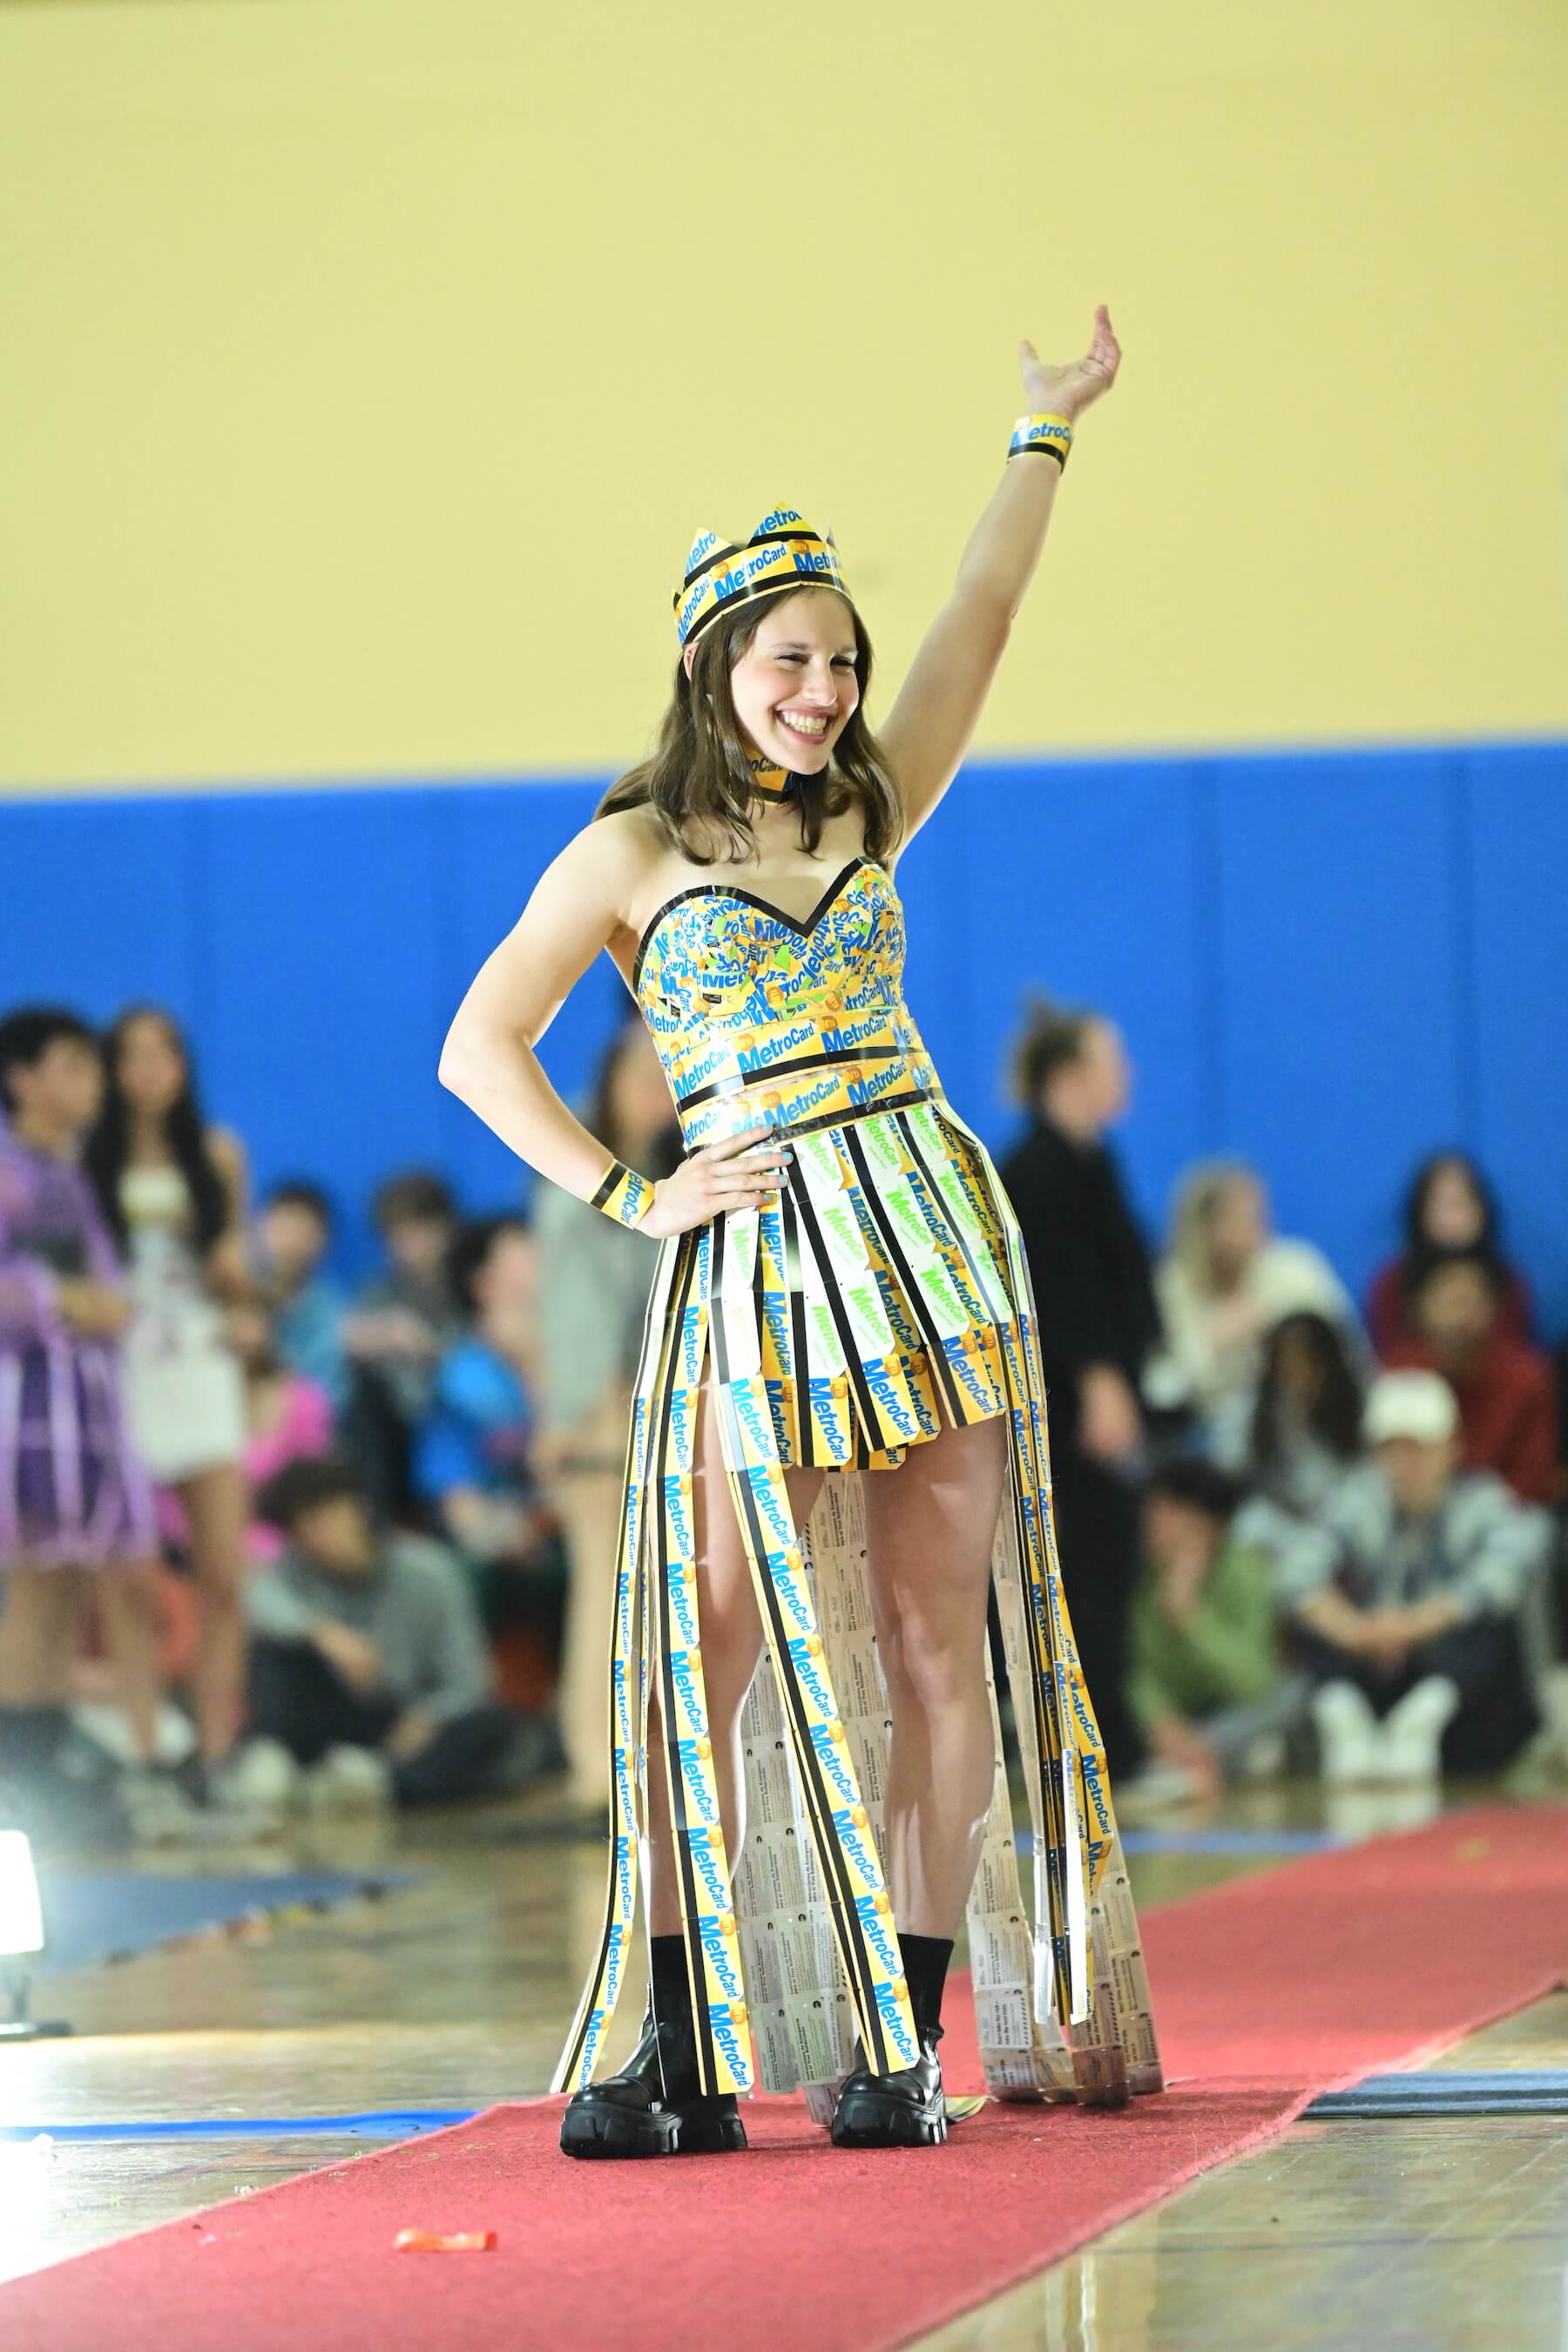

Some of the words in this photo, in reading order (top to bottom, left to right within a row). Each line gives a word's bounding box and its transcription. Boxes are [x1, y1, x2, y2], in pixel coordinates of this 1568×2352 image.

[737, 1022, 814, 1077] MetroCard
[821, 1012, 887, 1054] MetroCard
[762, 1077, 841, 1131] MetroCard
[846, 1060, 908, 1108] MetroCard
[905, 1171, 956, 1247] MetroCard
[683, 1305, 700, 1383] MetroCard
[762, 1292, 792, 1375] MetroCard
[942, 1335, 997, 1414] MetroCard
[1001, 1321, 1026, 1402] MetroCard
[1019, 1313, 1041, 1396] MetroCard
[669, 1389, 689, 1470] MetroCard
[730, 1378, 774, 1459] MetroCard
[765, 1379, 794, 1464] MetroCard
[808, 1378, 848, 1460] MetroCard
[861, 1358, 917, 1436] MetroCard
[635, 1397, 646, 1480] MetroCard
[1011, 1408, 1036, 1490] MetroCard
[627, 1485, 637, 1568] MetroCard
[663, 1474, 691, 1557] MetroCard
[747, 1464, 794, 1546] MetroCard
[1020, 1497, 1044, 1578] MetroCard
[1037, 1487, 1058, 1571] MetroCard
[618, 1572, 631, 1655] MetroCard
[666, 1563, 695, 1646] MetroCard
[767, 1551, 813, 1632] MetroCard
[613, 1659, 630, 1743] MetroCard
[670, 1651, 705, 1734] MetroCard
[787, 1637, 835, 1719] MetroCard
[614, 1748, 634, 1831] MetroCard
[678, 1739, 716, 1822] MetroCard
[809, 1723, 857, 1805] MetroCard
[1082, 1754, 1111, 1835] MetroCard
[617, 1835, 632, 1920] MetroCard
[688, 1827, 729, 1910] MetroCard
[832, 1809, 882, 1889] MetroCard
[606, 1924, 624, 2006] MetroCard
[698, 1915, 740, 1999] MetroCard
[855, 1895, 901, 1977] MetroCard
[707, 2004, 751, 2087] MetroCard
[874, 1981, 917, 2064] MetroCard
